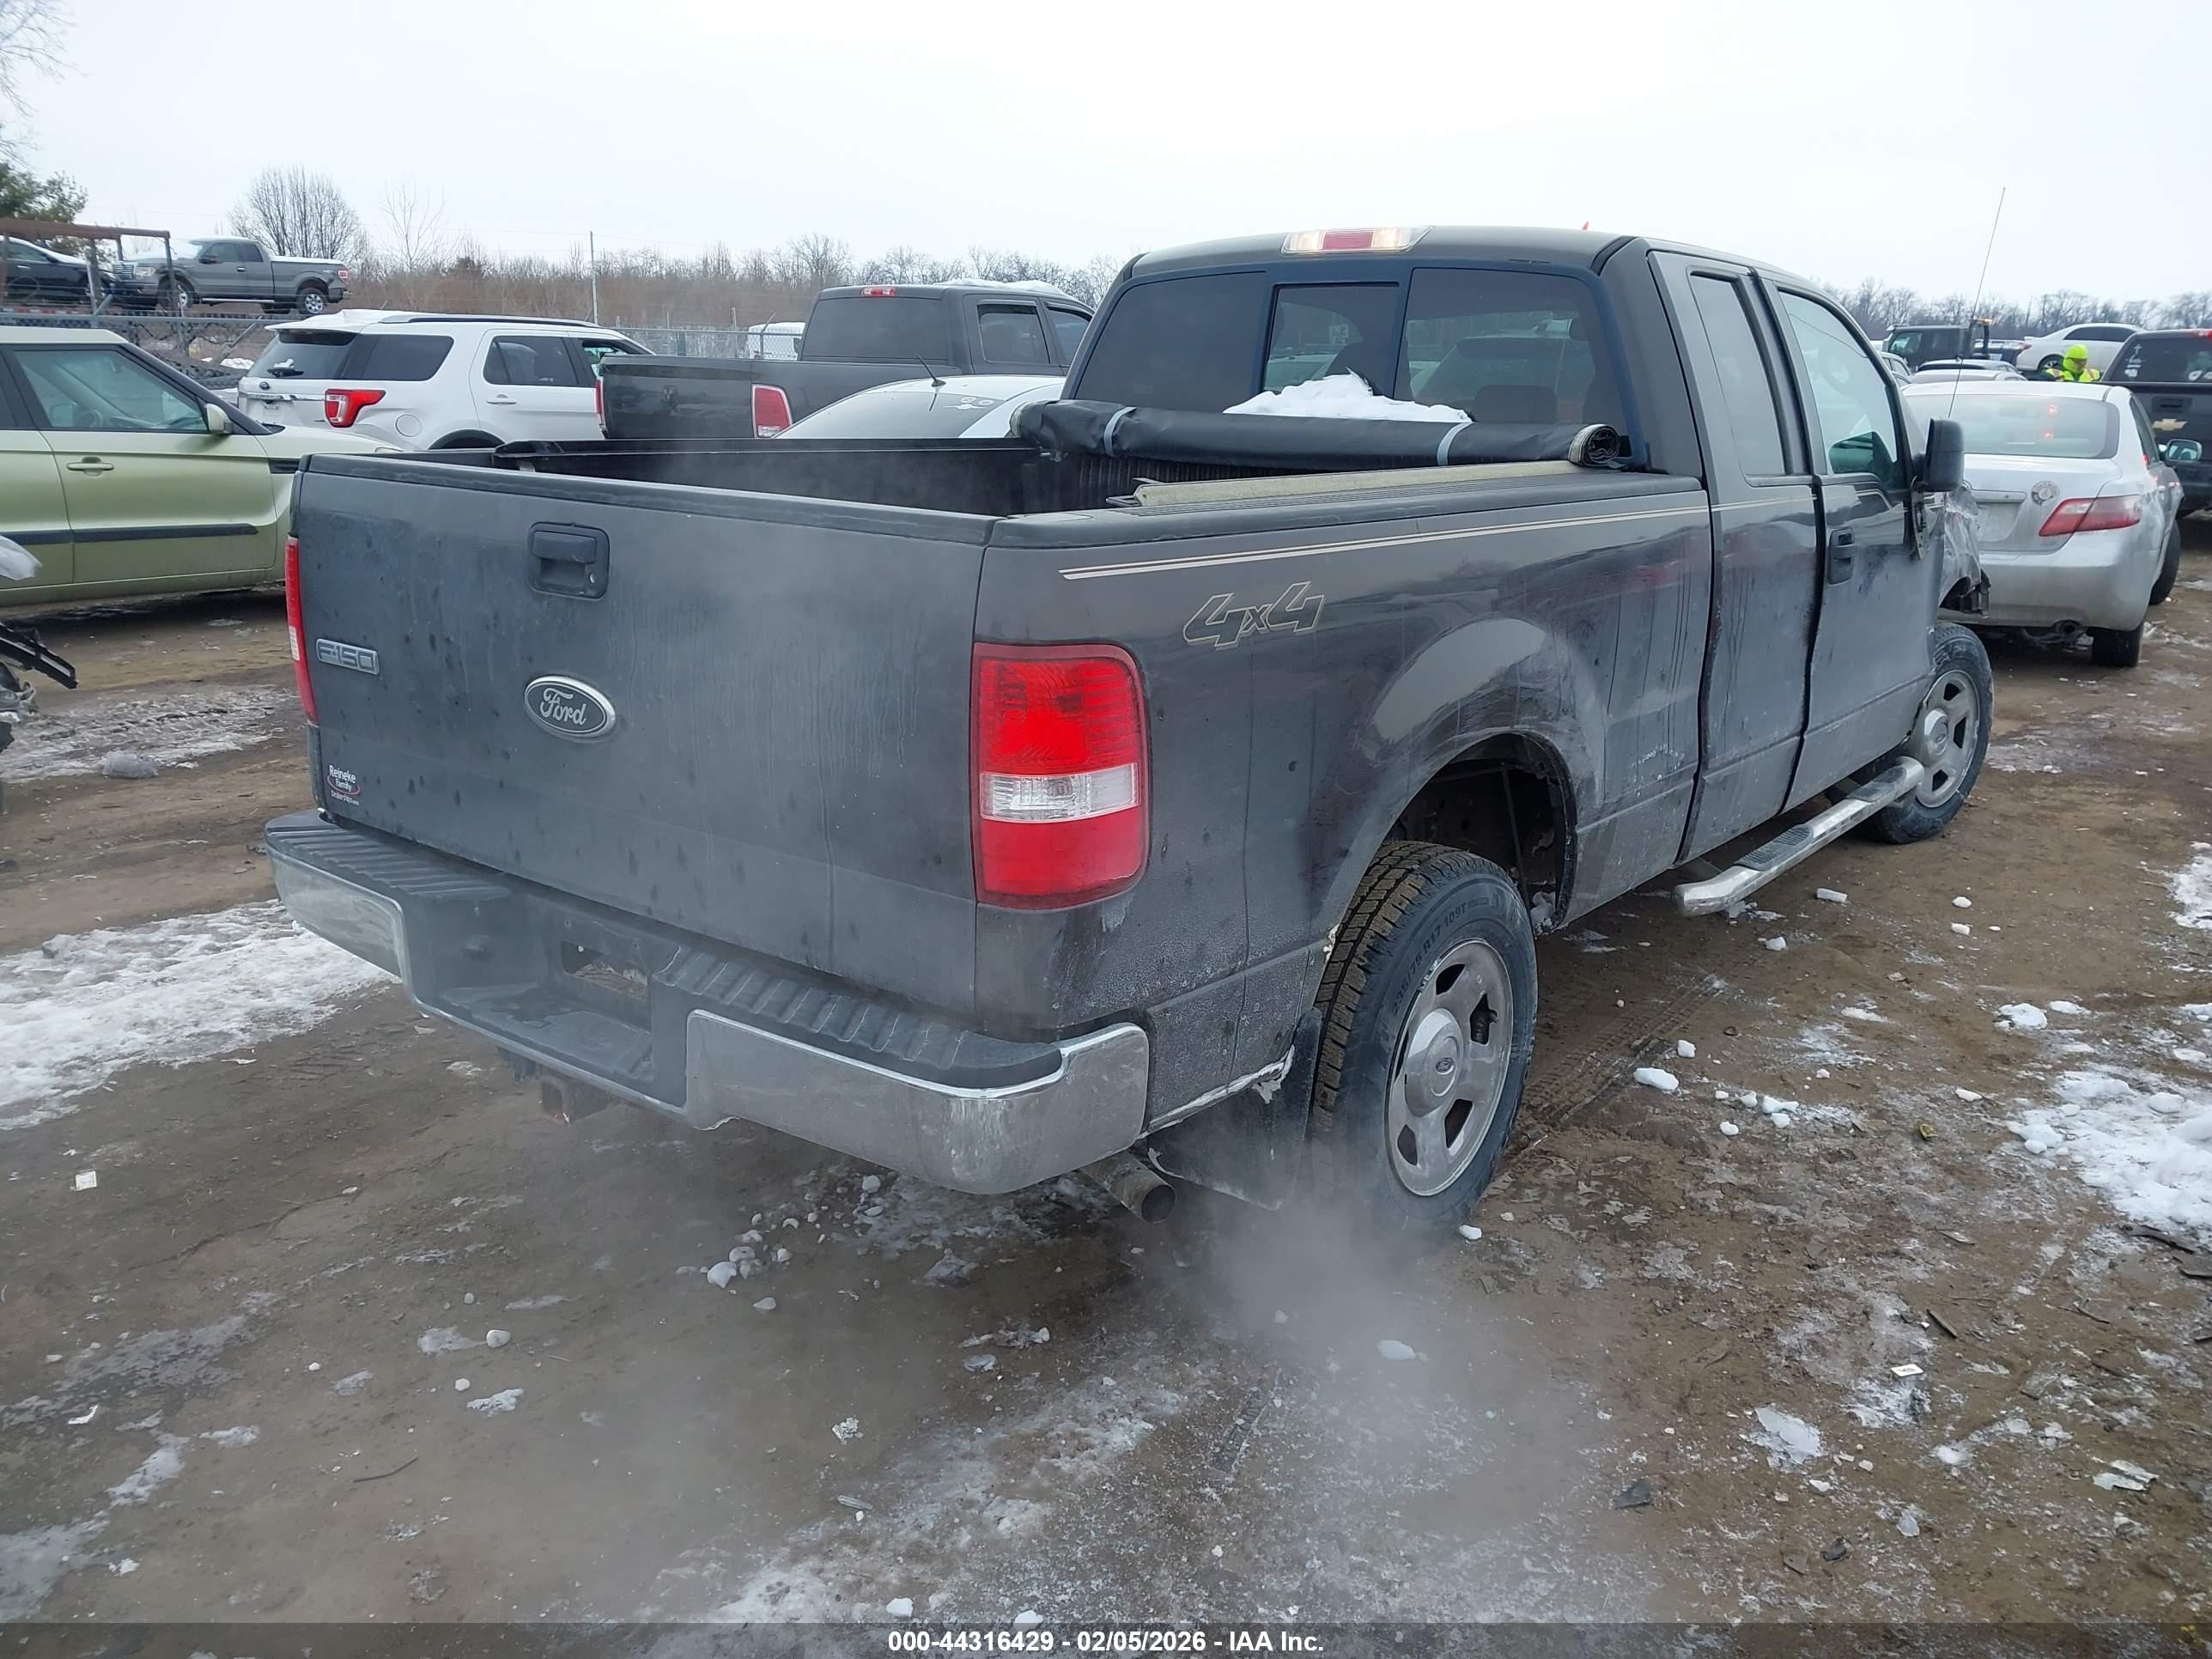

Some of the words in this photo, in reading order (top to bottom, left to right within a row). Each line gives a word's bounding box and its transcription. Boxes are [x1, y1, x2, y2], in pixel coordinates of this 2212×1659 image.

[1182, 581, 1325, 651] 4x4
[539, 687, 586, 726] Ford
[329, 764, 356, 784] Reineke
